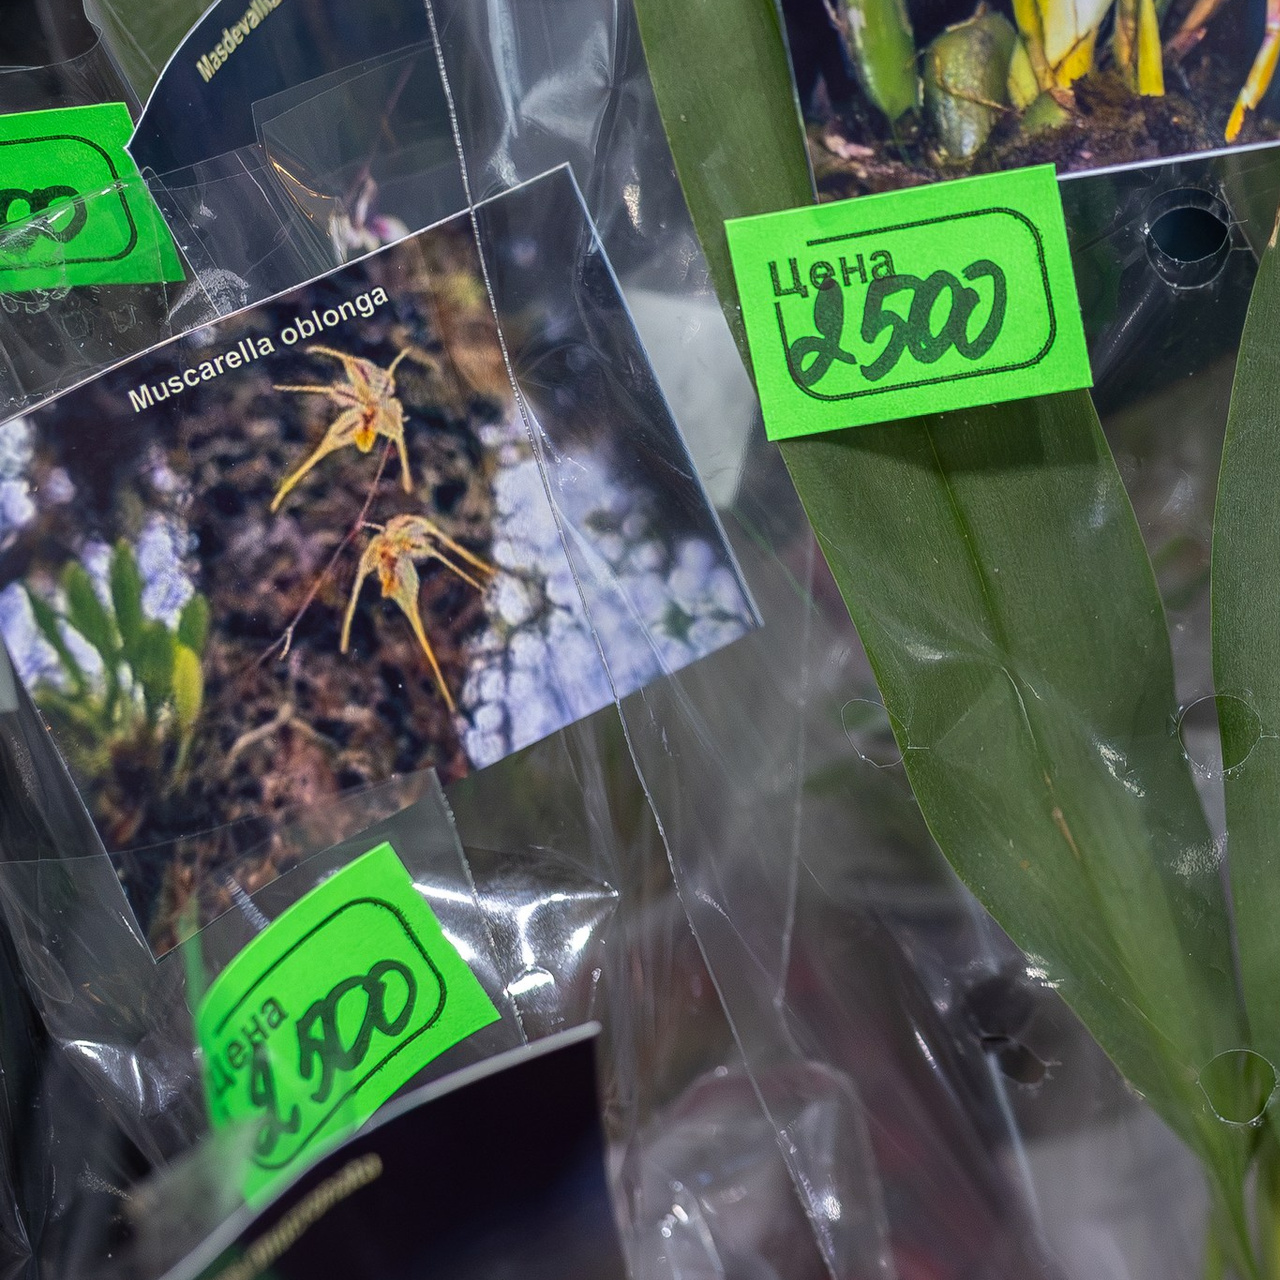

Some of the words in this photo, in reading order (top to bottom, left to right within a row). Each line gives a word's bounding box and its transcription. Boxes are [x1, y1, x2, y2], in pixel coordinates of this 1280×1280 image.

[768, 249, 897, 298] Цена
[788, 259, 1007, 387] 2500
[128, 334, 276, 413] Muscarella
[280, 286, 390, 346] oblonga
